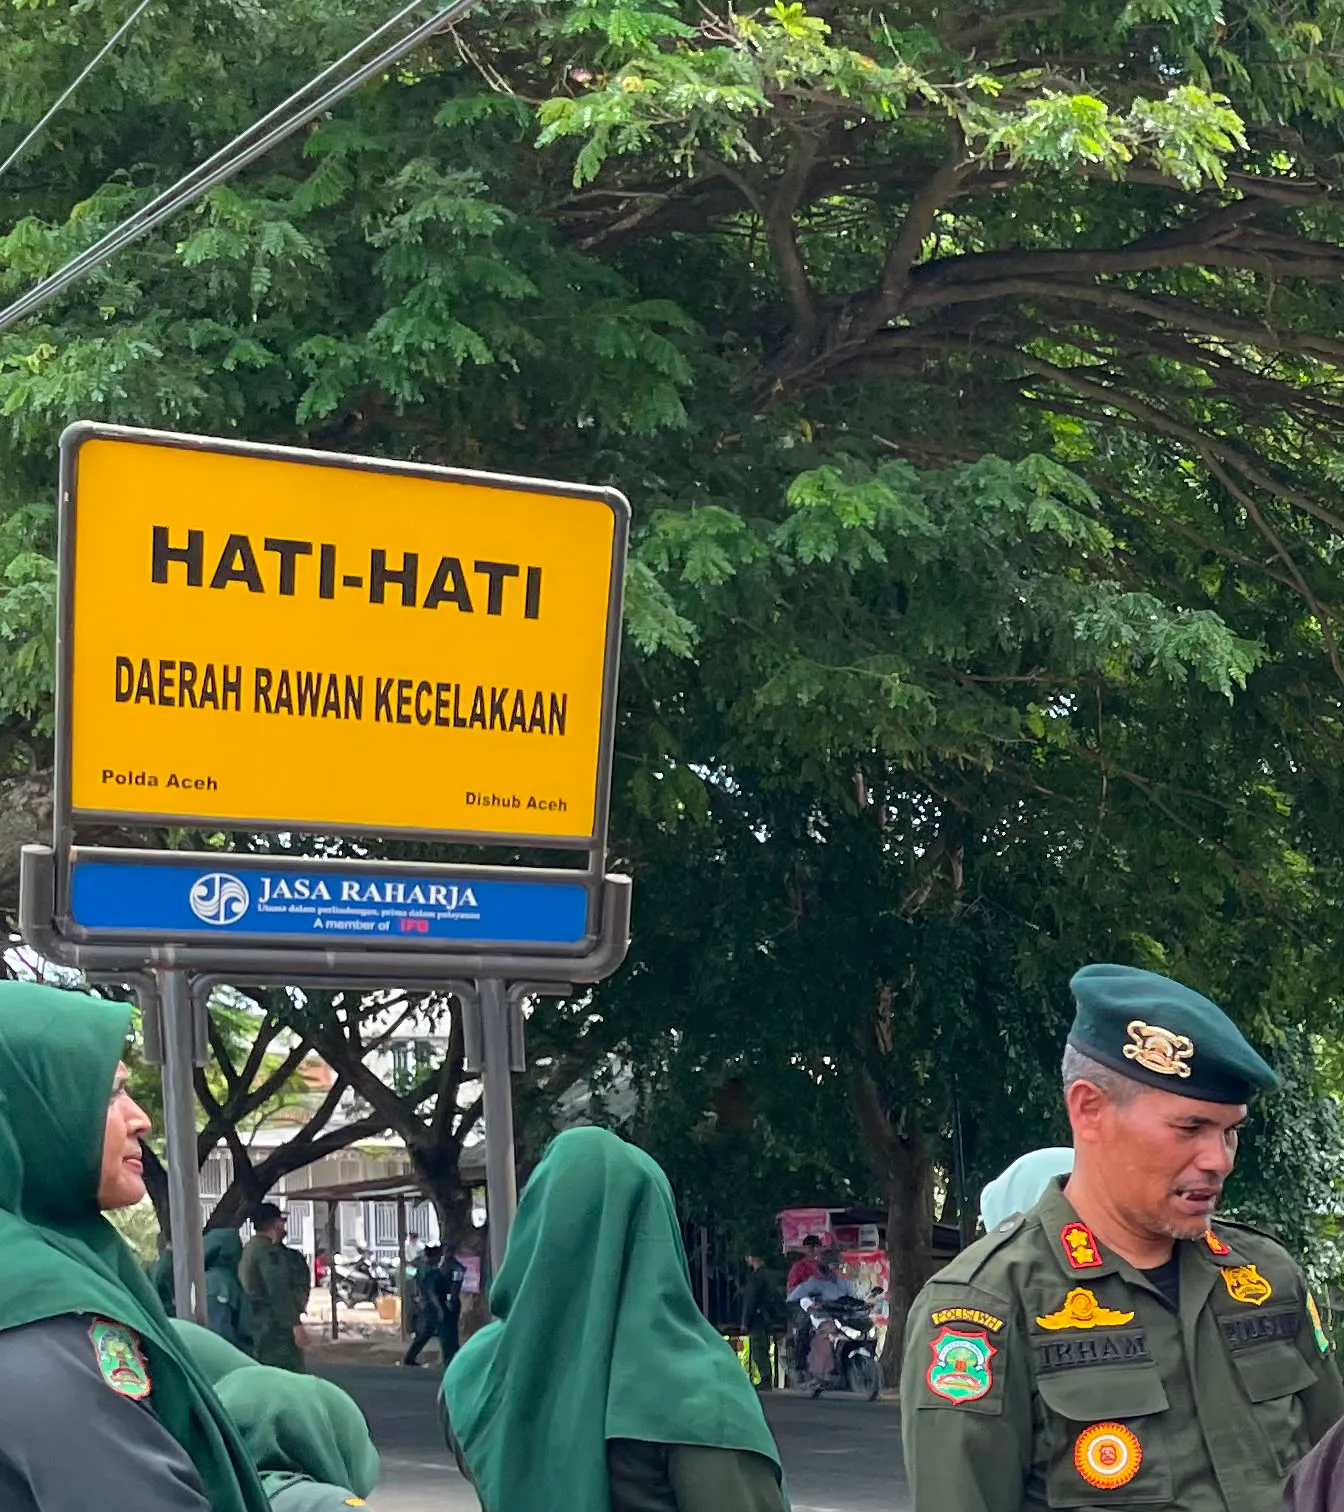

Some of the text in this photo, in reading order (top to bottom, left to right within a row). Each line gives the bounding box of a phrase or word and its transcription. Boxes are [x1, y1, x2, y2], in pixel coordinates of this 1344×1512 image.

[150, 524, 543, 620] HATI-HATI
[114, 655, 568, 736] DAERAH RAWAN KECELAKAAN
[101, 768, 219, 792] Polda Aceh
[464, 791, 568, 812] Dishub Aceh
[258, 877, 479, 909] JASA RAHARJA
[313, 918, 323, 929] A
[325, 919, 376, 931] member
[377, 920, 390, 931] of
